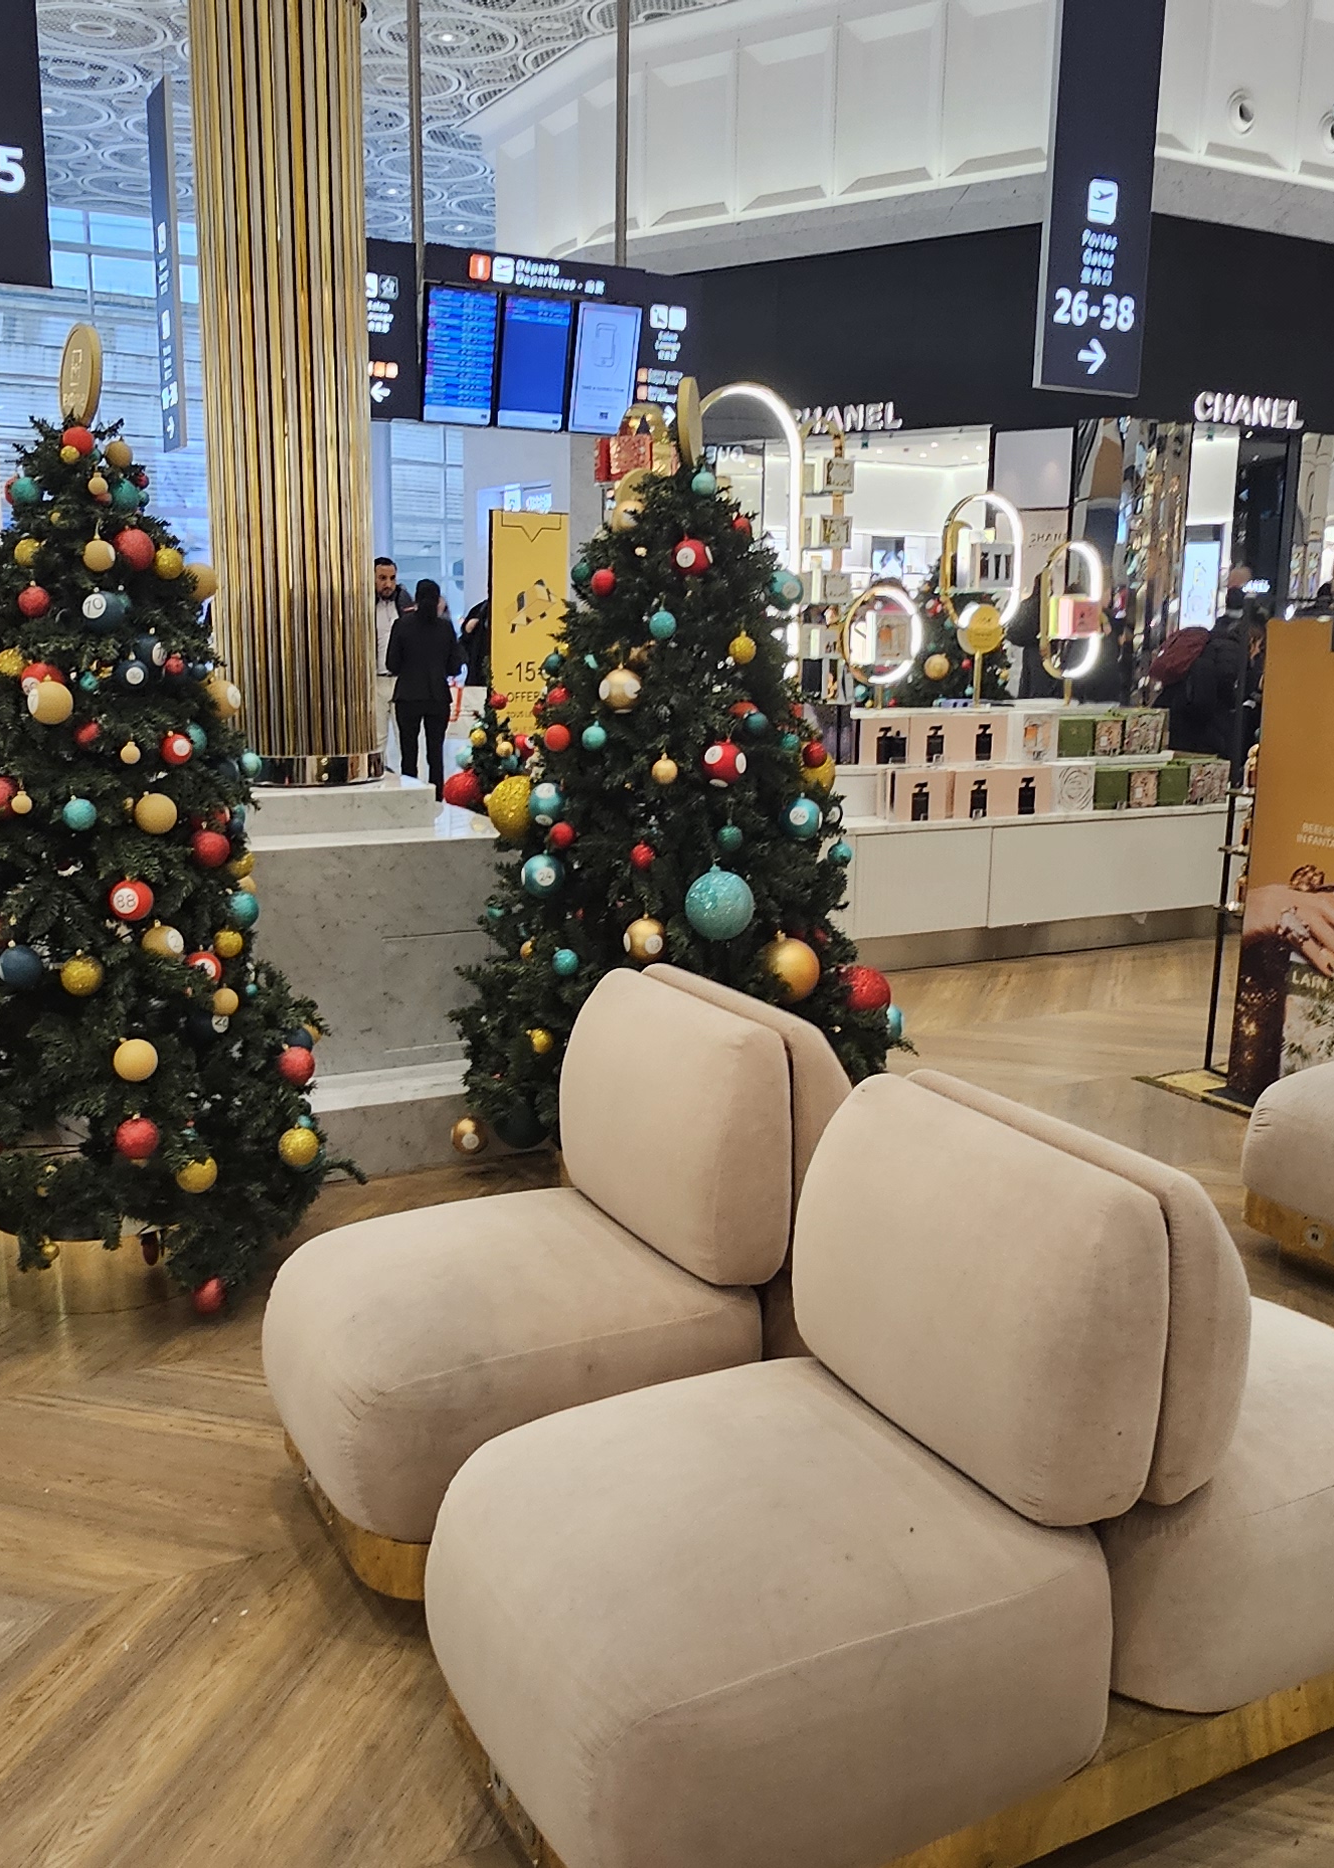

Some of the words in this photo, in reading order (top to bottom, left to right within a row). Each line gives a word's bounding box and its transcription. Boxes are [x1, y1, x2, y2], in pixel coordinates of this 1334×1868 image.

[1053, 287, 1135, 332] 26-38
[1194, 391, 1304, 430] CHANEL
[84, 597, 104, 613] 10
[115, 893, 136, 909] 88
[1292, 971, 1328, 991] LAIN
